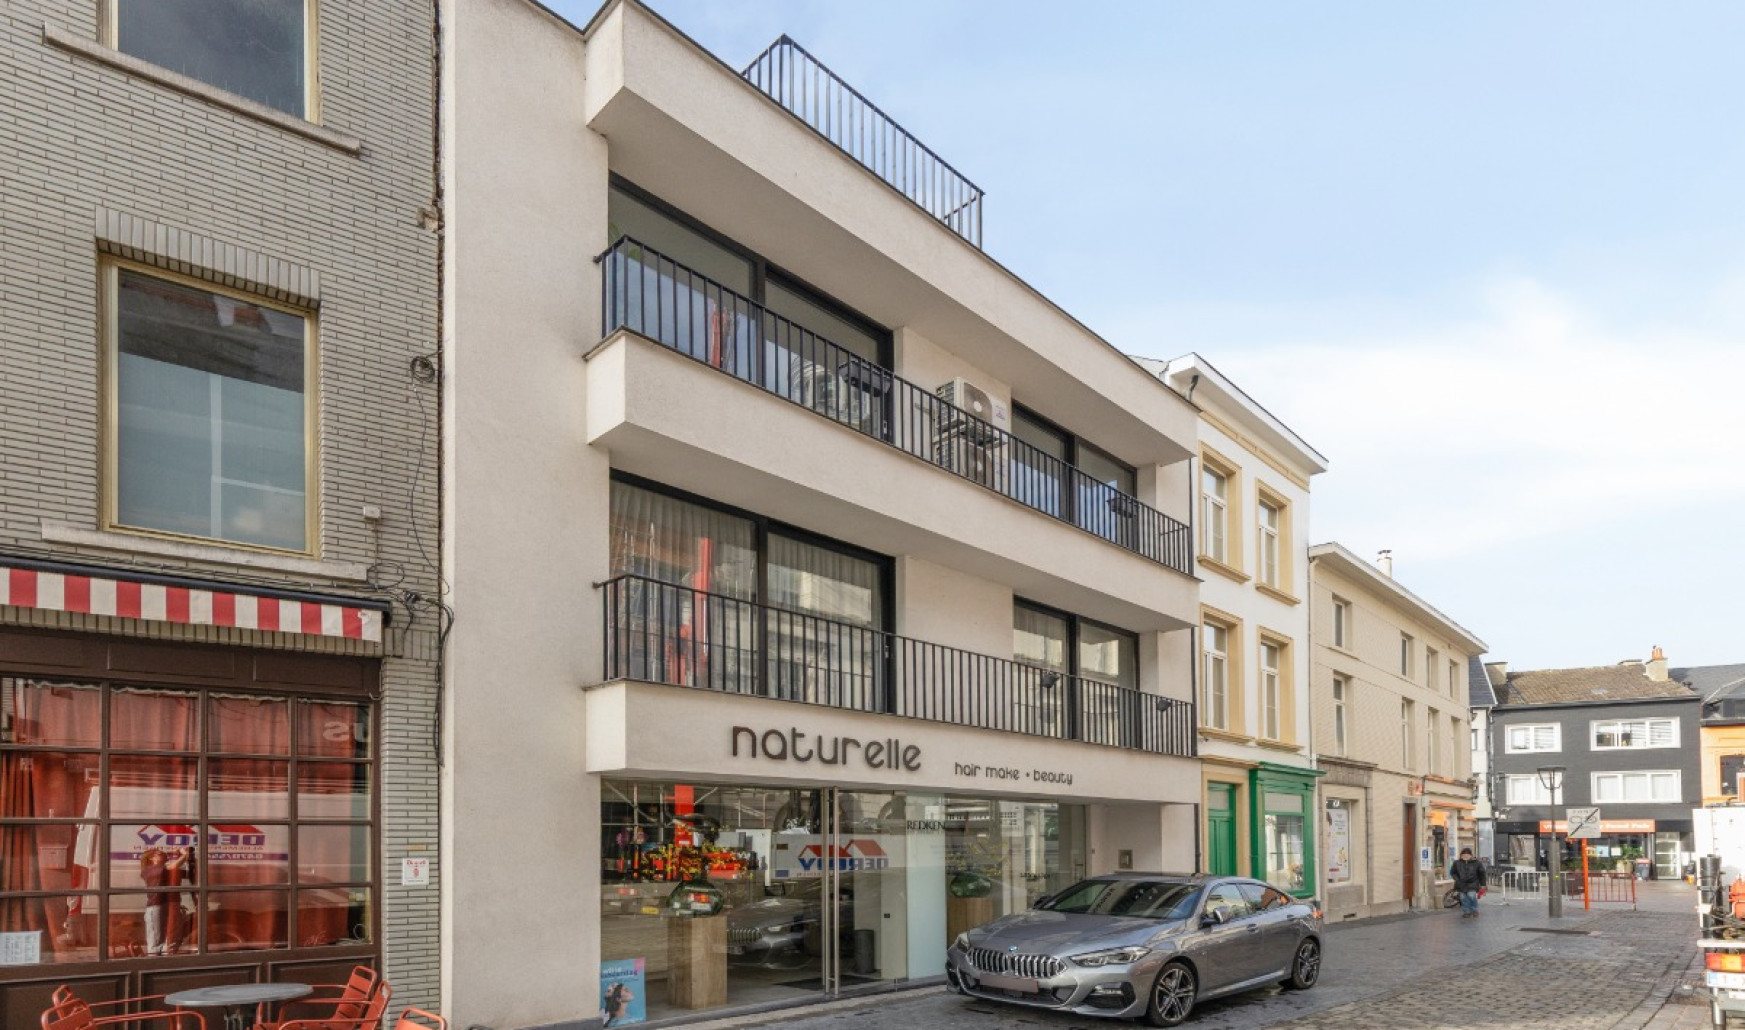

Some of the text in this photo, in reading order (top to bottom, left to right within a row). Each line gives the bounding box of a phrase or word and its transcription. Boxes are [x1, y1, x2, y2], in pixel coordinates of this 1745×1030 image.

[731, 725, 922, 773] naturelle
[954, 761, 981, 777] hair
[985, 766, 1020, 781] make
[1033, 769, 1073, 786] beauty
[906, 820, 946, 830] REDKEN
